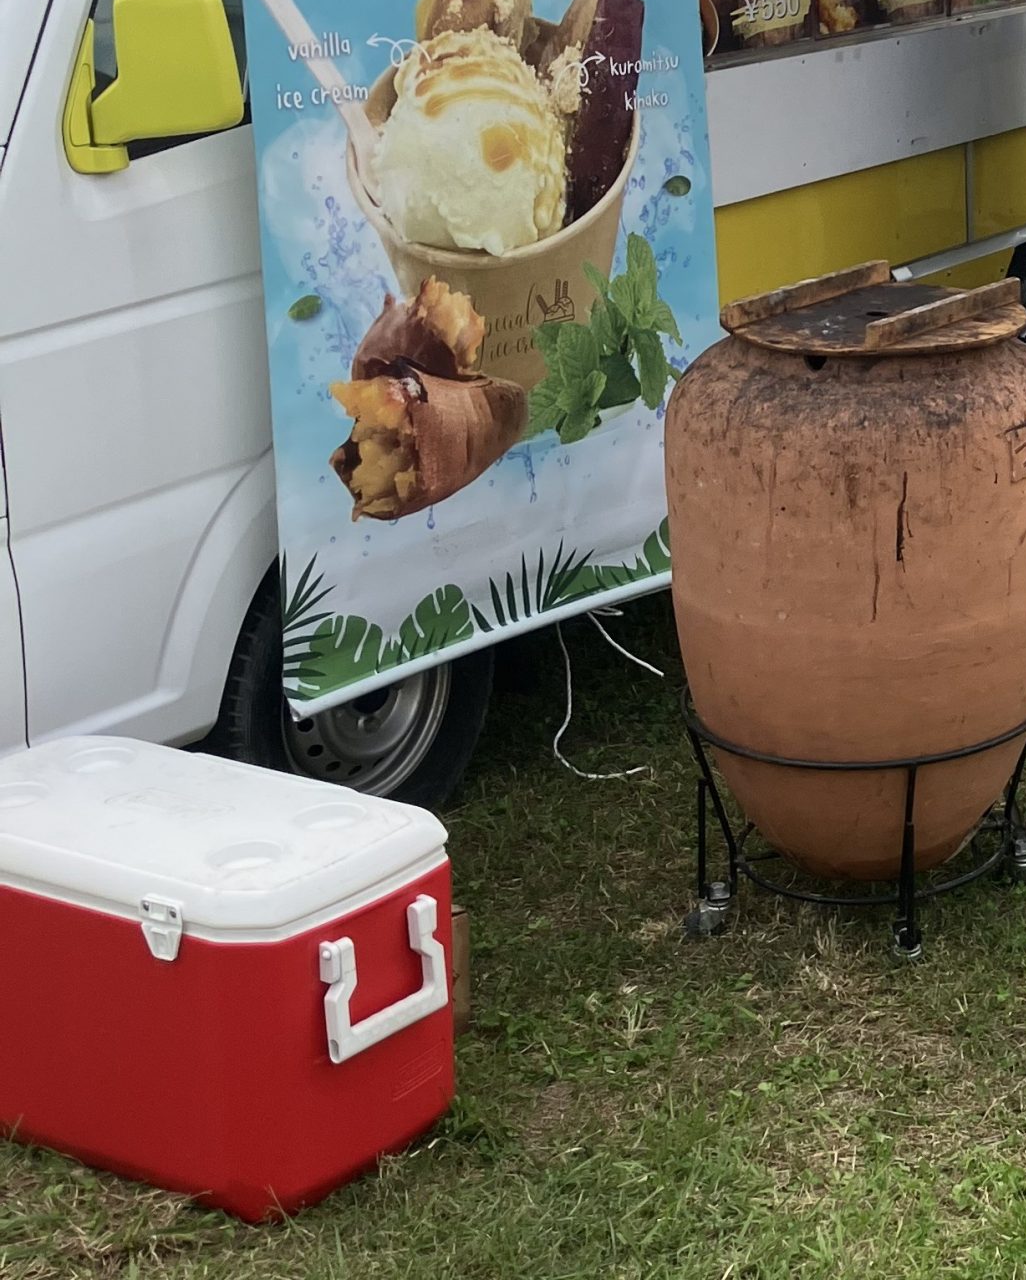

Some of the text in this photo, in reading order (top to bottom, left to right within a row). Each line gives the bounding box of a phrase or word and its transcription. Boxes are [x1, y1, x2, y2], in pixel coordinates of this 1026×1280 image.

[287, 33, 351, 61] vanilla
[609, 53, 679, 77] kuromitsu
[275, 82, 369, 110] ice cream
[624, 90, 670, 113] kinako
